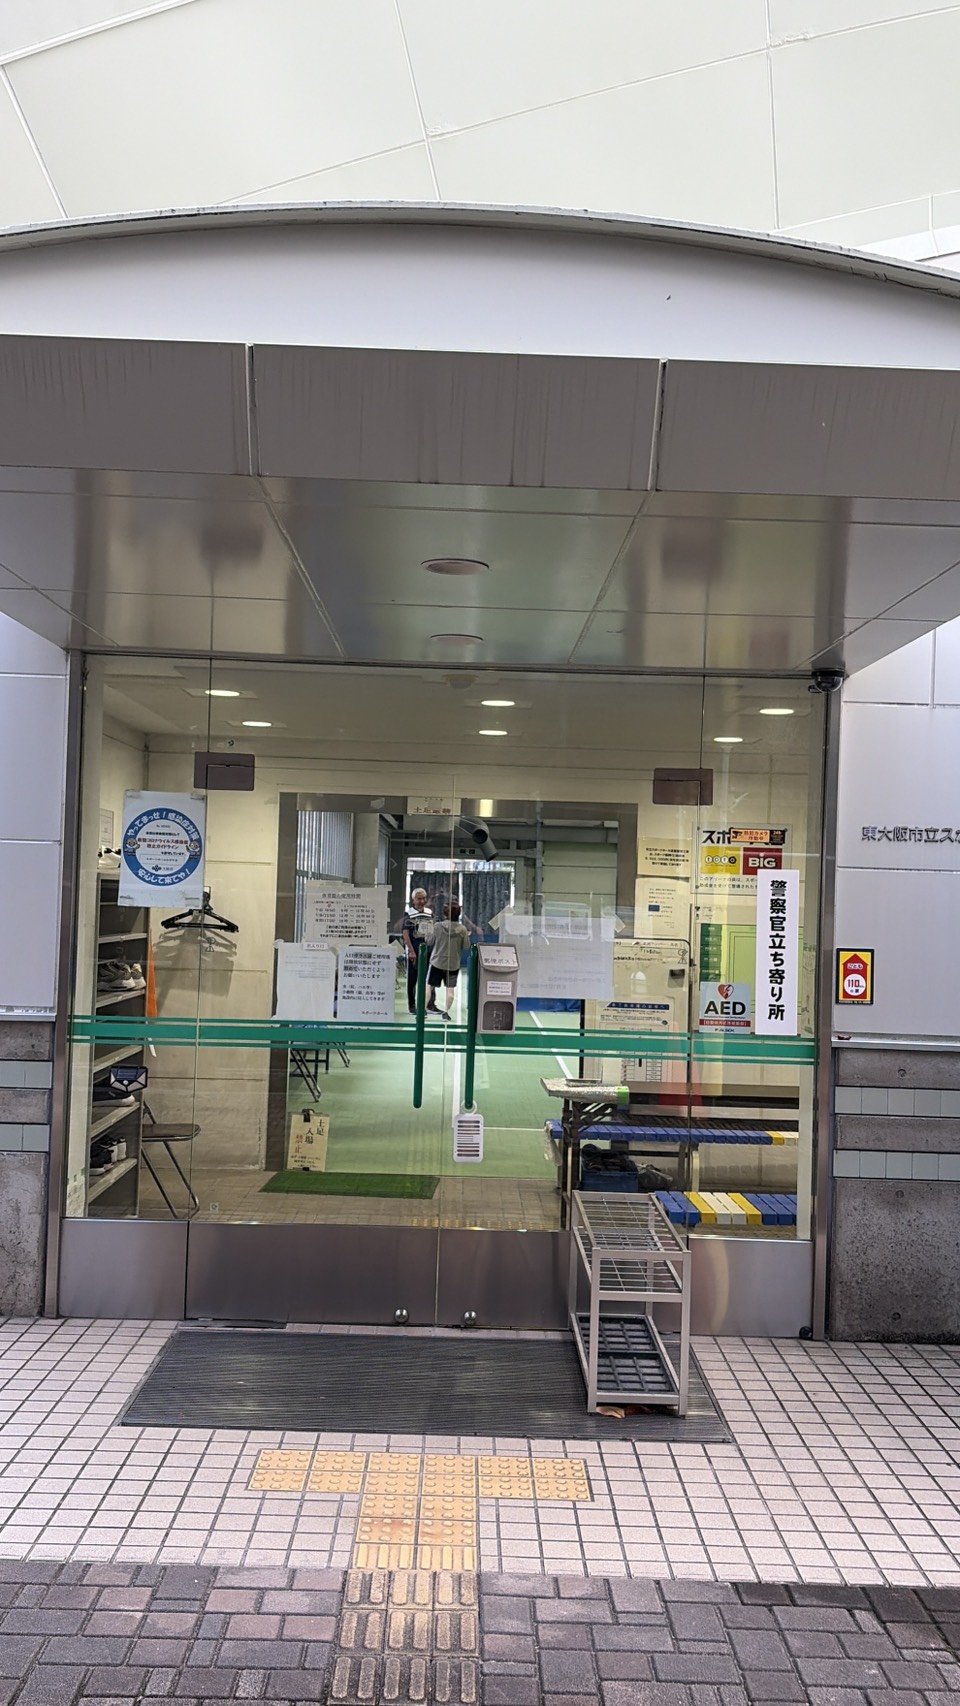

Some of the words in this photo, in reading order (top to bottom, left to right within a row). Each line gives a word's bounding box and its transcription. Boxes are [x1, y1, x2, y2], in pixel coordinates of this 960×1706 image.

[768, 880, 788, 1021] 警察官立ち寄り所
[704, 1001, 747, 1016] AED
